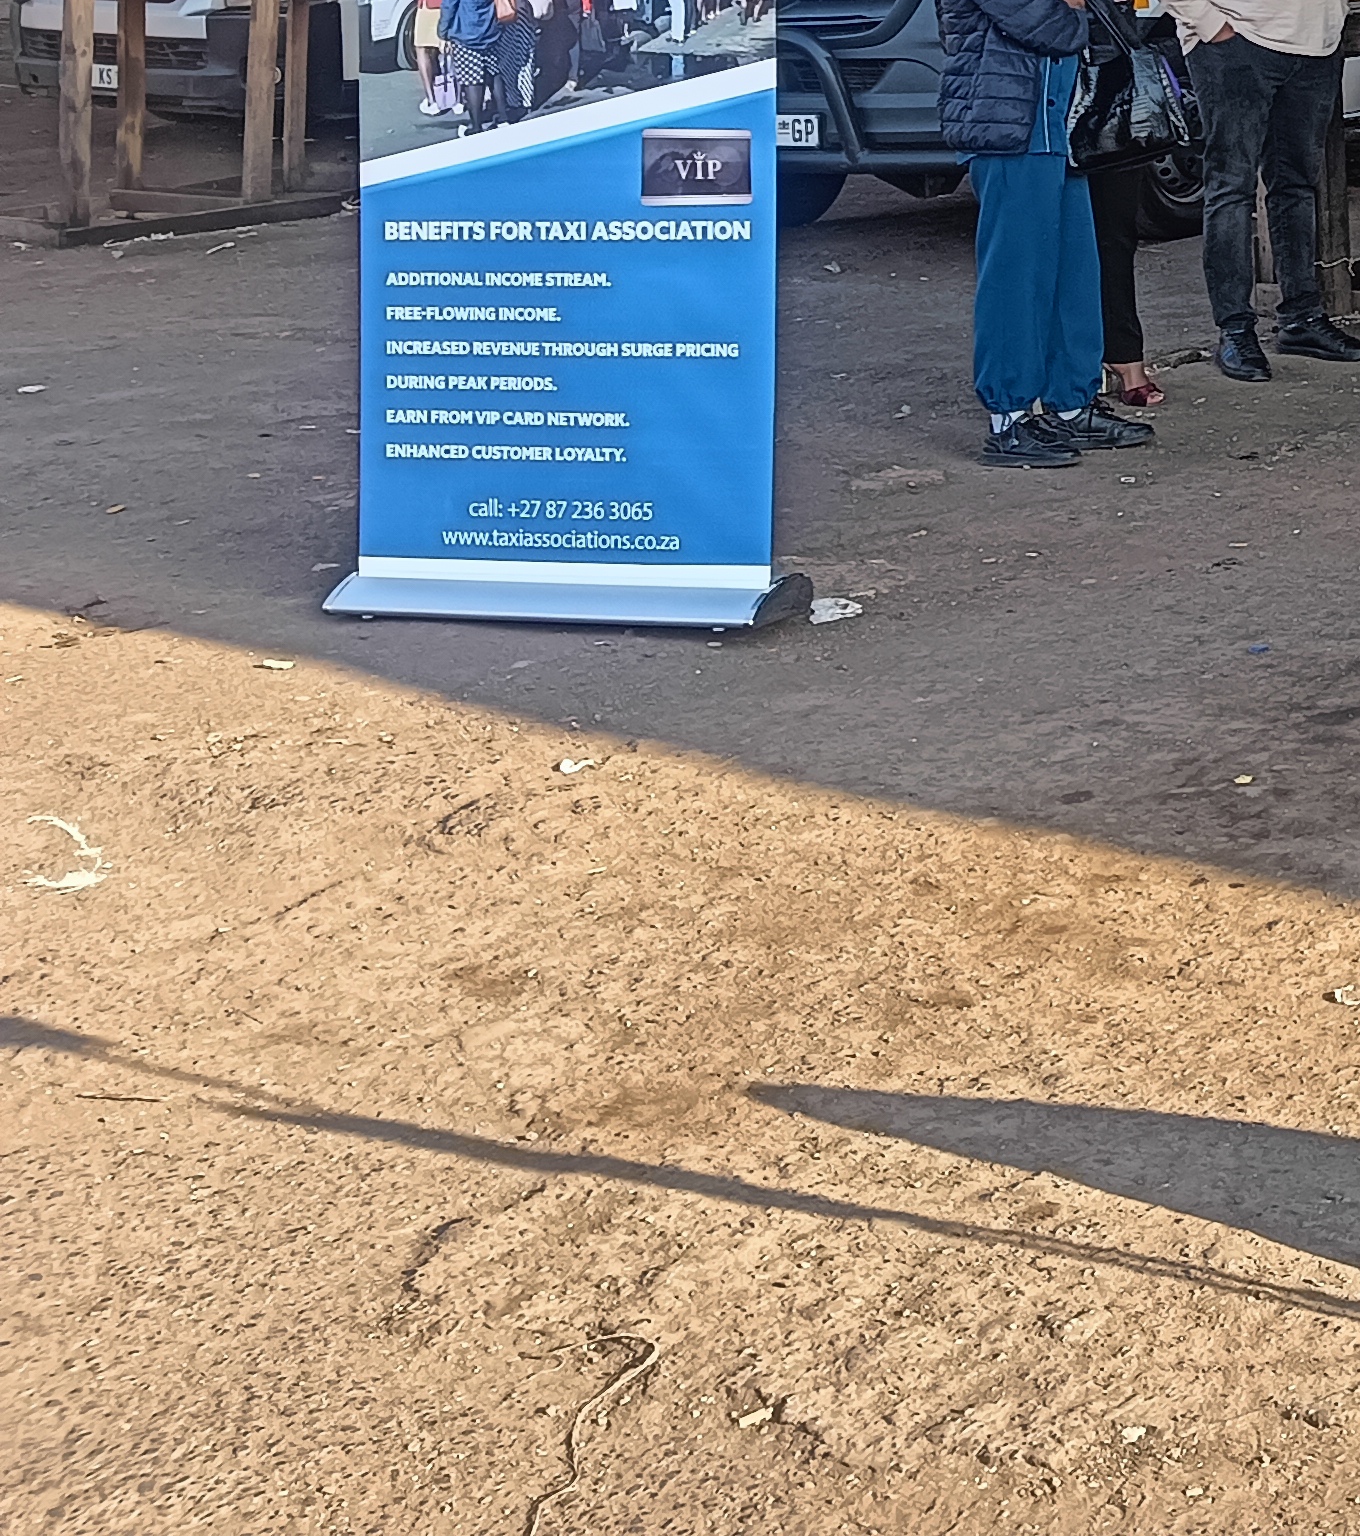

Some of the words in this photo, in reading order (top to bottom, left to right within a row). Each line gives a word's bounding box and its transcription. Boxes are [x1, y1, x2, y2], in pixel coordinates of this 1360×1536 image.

[98, 67, 112, 85] KS
[791, 118, 815, 143] GP
[674, 159, 722, 180] VIP
[384, 221, 486, 241] BENEFITS
[489, 221, 533, 241] FOR
[535, 221, 587, 241] TAXI
[590, 220, 751, 241] ASSOCIATION
[385, 272, 483, 287] ADDITIONAL
[485, 272, 544, 287] INCOME
[545, 272, 612, 287] STREAM.
[386, 306, 496, 321] FREE-FLOWING
[498, 307, 562, 322] INCOME.
[386, 340, 470, 355] INCREASED
[472, 341, 540, 356] REVENUE
[541, 342, 619, 357] THROUGH
[621, 342, 673, 357] SURGE
[675, 343, 739, 358] PRICING
[386, 375, 446, 390] DURING
[448, 375, 488, 390] PEAK
[490, 376, 558, 391] PERIODS.
[386, 409, 428, 424] EARN
[430, 409, 473, 425] FROM
[474, 410, 501, 425] VIP
[502, 411, 545, 426] CARD
[546, 411, 630, 427] NETWORK.
[385, 444, 470, 459] ENHANCED
[471, 445, 553, 461] CUSTOMER
[554, 447, 627, 462] LOYALTY.
[468, 498, 503, 518] call:
[507, 500, 541, 519] +27
[545, 500, 568, 519] 87
[571, 501, 605, 520] 236
[608, 501, 653, 521] 3065
[442, 528, 680, 551] www.taxiassociations.co.za
